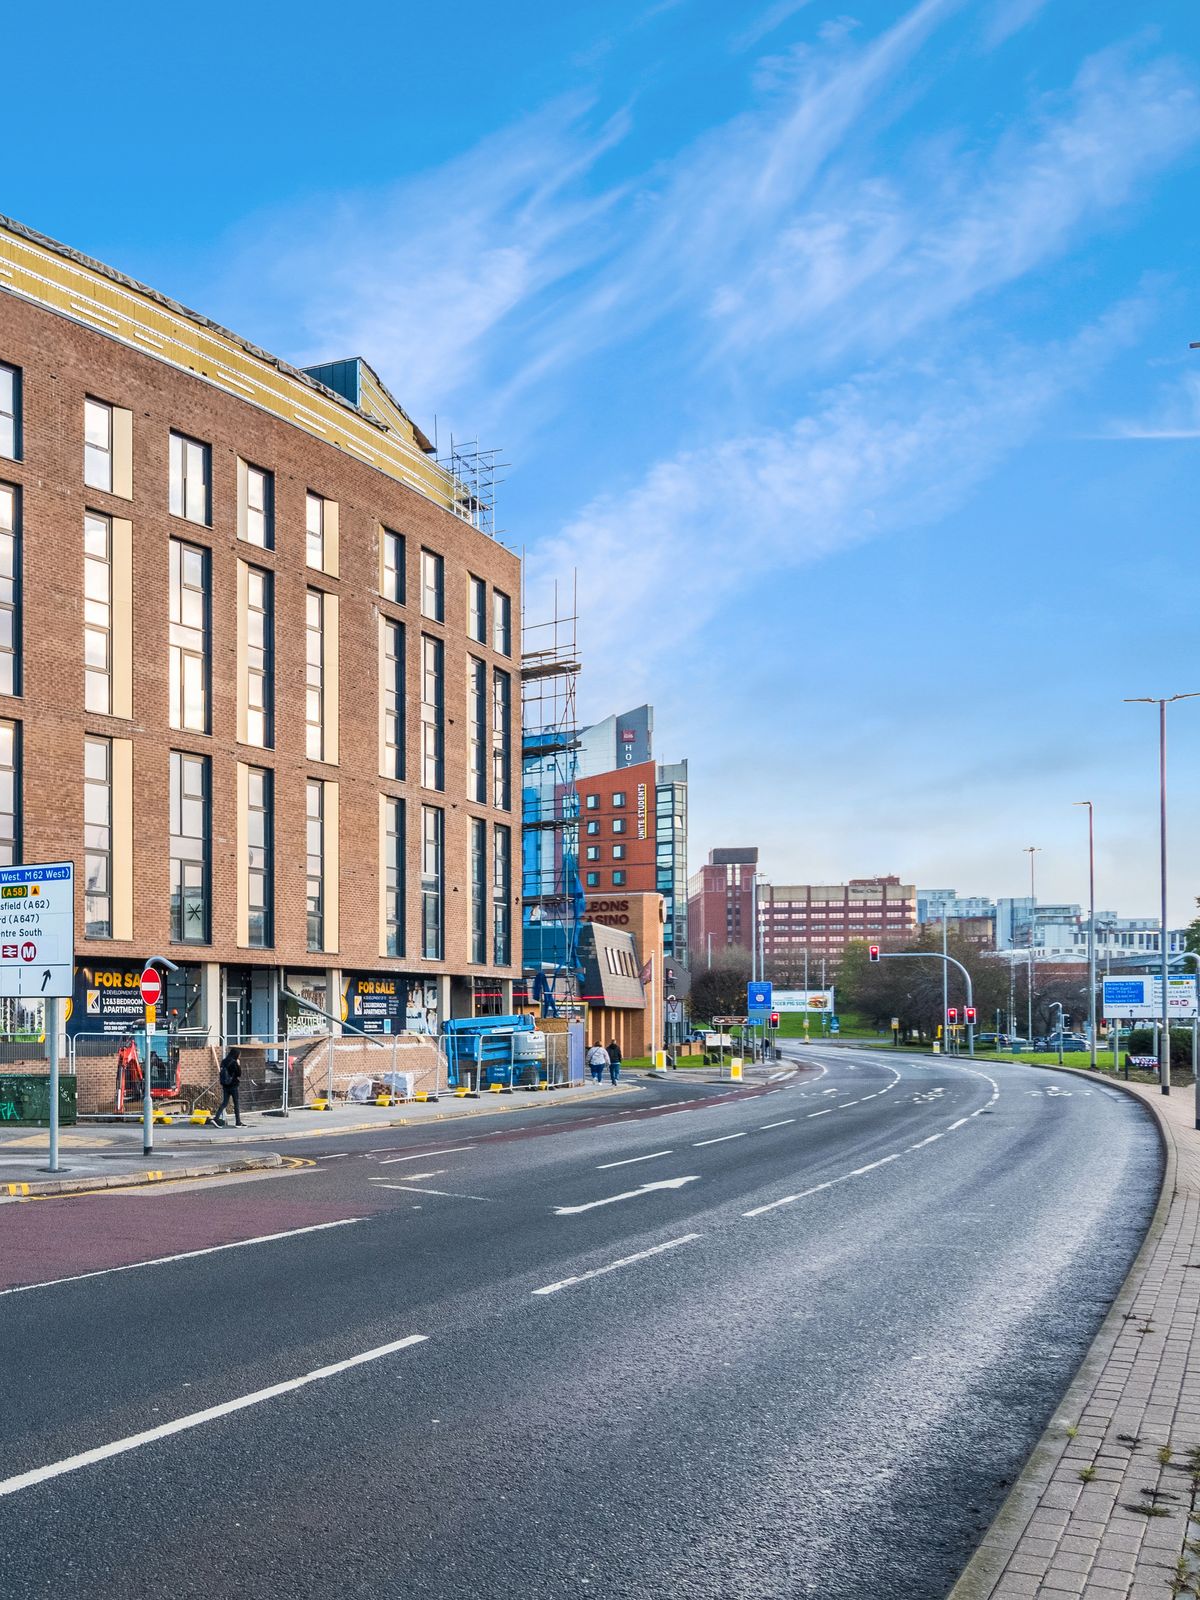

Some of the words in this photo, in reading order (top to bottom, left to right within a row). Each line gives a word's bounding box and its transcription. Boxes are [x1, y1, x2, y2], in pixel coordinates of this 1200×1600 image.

[24, 871, 43, 880] M62
[46, 868, 70, 878] West)
[2, 886, 27, 897] (A58)
[24, 899, 50, 910] (A62)
[9, 914, 40, 924] (A647)
[19, 928, 42, 937] South
[95, 972, 122, 987] FOR
[124, 972, 141, 987] SA
[358, 982, 374, 993] FOR
[376, 983, 394, 994] SALE
